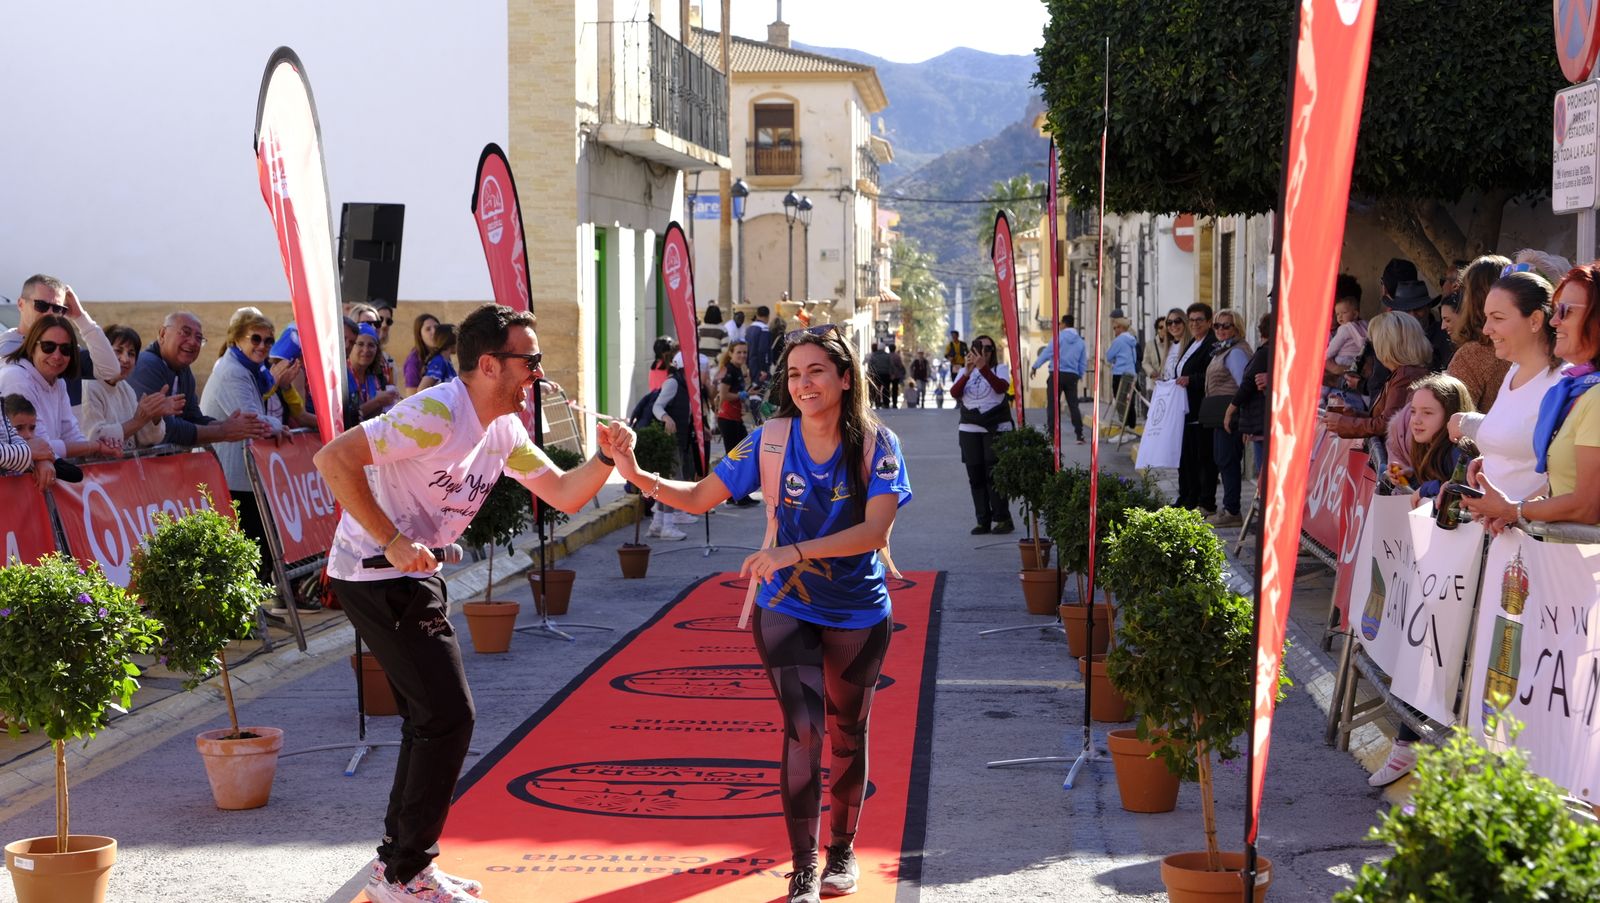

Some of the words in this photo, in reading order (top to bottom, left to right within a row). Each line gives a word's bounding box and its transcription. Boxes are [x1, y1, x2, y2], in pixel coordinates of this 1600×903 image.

[1567, 88, 1597, 110] PROHIBIDO
[1568, 122, 1595, 139] ESTACIONAR
[1553, 150, 1560, 163] EN
[1560, 147, 1572, 162] TODA
[1573, 145, 1580, 160] LA
[1580, 142, 1596, 158] PLAZA
[635, 719, 774, 727] Cantoria
[522, 853, 708, 864] Cantoria
[723, 857, 777, 866] de
[485, 865, 786, 879] Ayuntamiento
